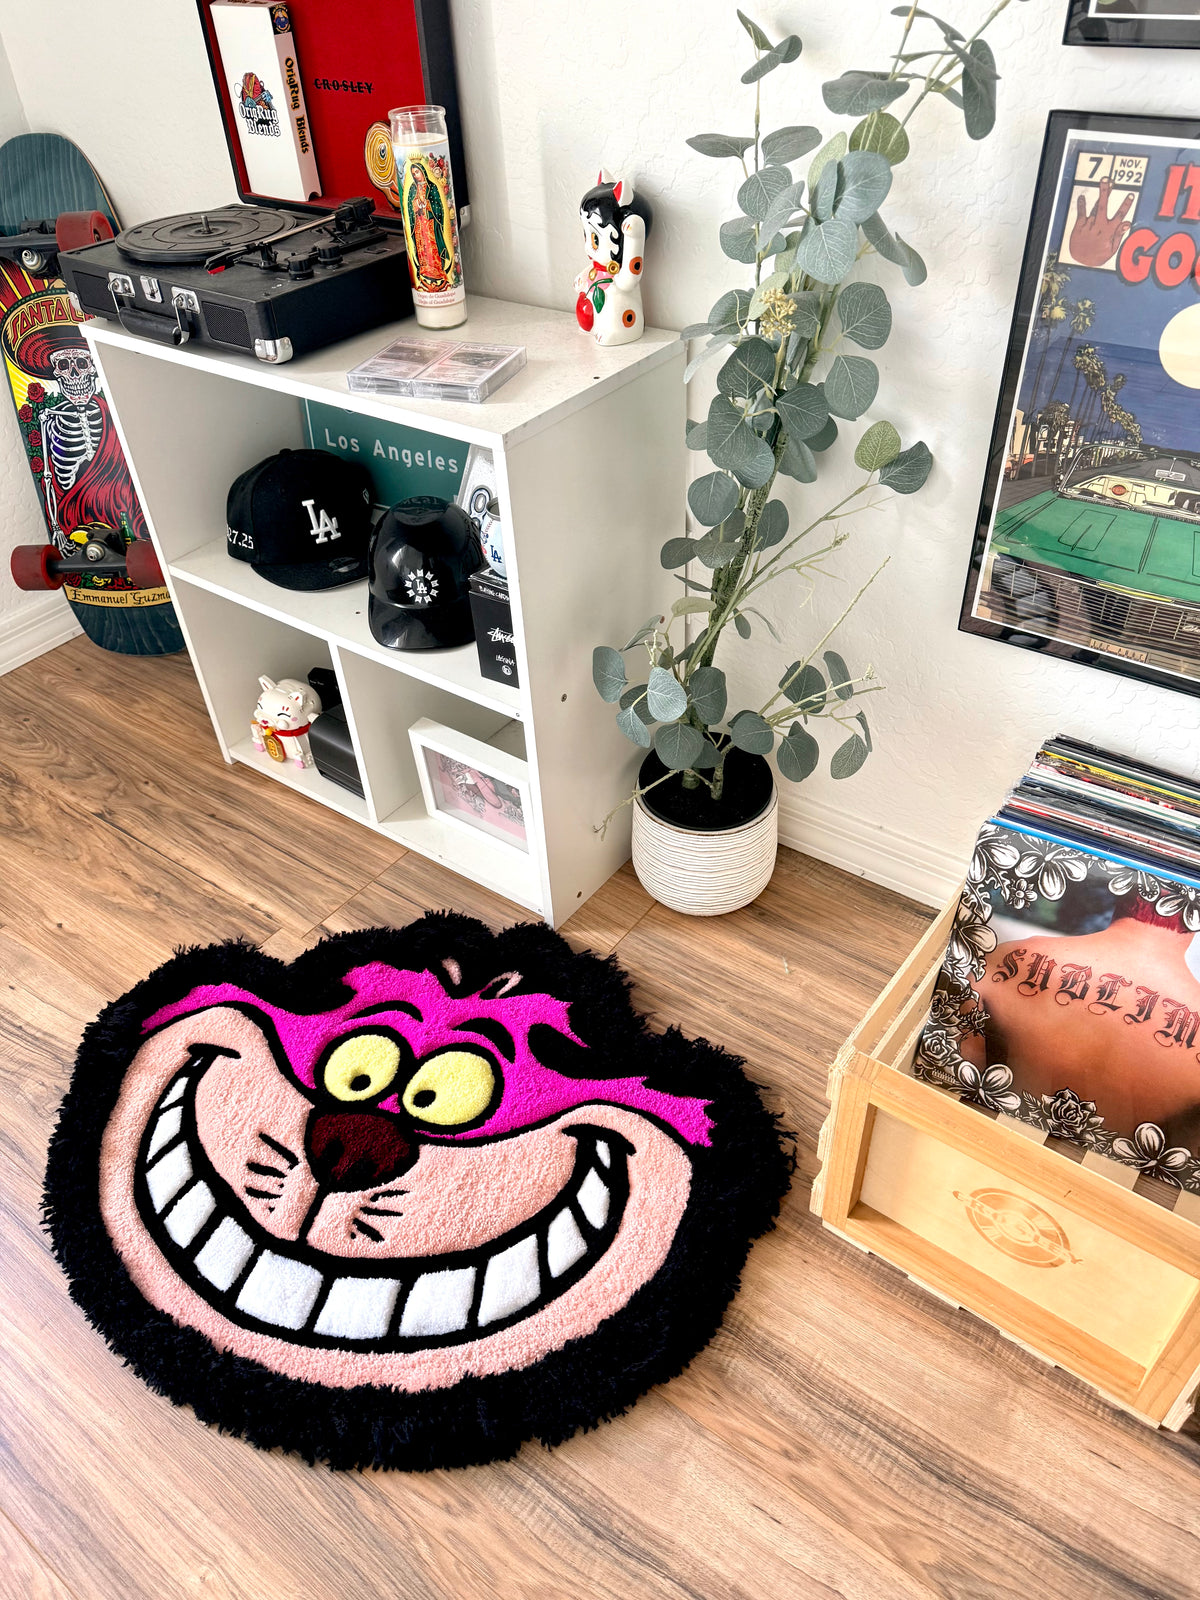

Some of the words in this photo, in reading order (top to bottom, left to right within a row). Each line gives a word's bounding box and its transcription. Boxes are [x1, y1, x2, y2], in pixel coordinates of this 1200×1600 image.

[314, 78, 374, 94] CROSLEY
[239, 102, 279, 124] OrigRug
[284, 56, 301, 112] OrigRug
[296, 115, 309, 154] Blends
[246, 118, 281, 137] Blends
[1088, 156, 1104, 179] 7
[1119, 158, 1143, 169] NOV.
[1113, 169, 1143, 183] 1992
[1117, 227, 1200, 289] GO
[10, 297, 69, 345] SANTA
[325, 428, 360, 453] Los
[373, 439, 459, 474] Angeles
[302, 499, 341, 544] LA
[490, 545, 502, 563] LA
[70, 589, 129, 605] Emmanuel
[129, 591, 171, 605] Guzma
[415, 579, 428, 594] LA
[992, 949, 1200, 1064] SUBLIM
